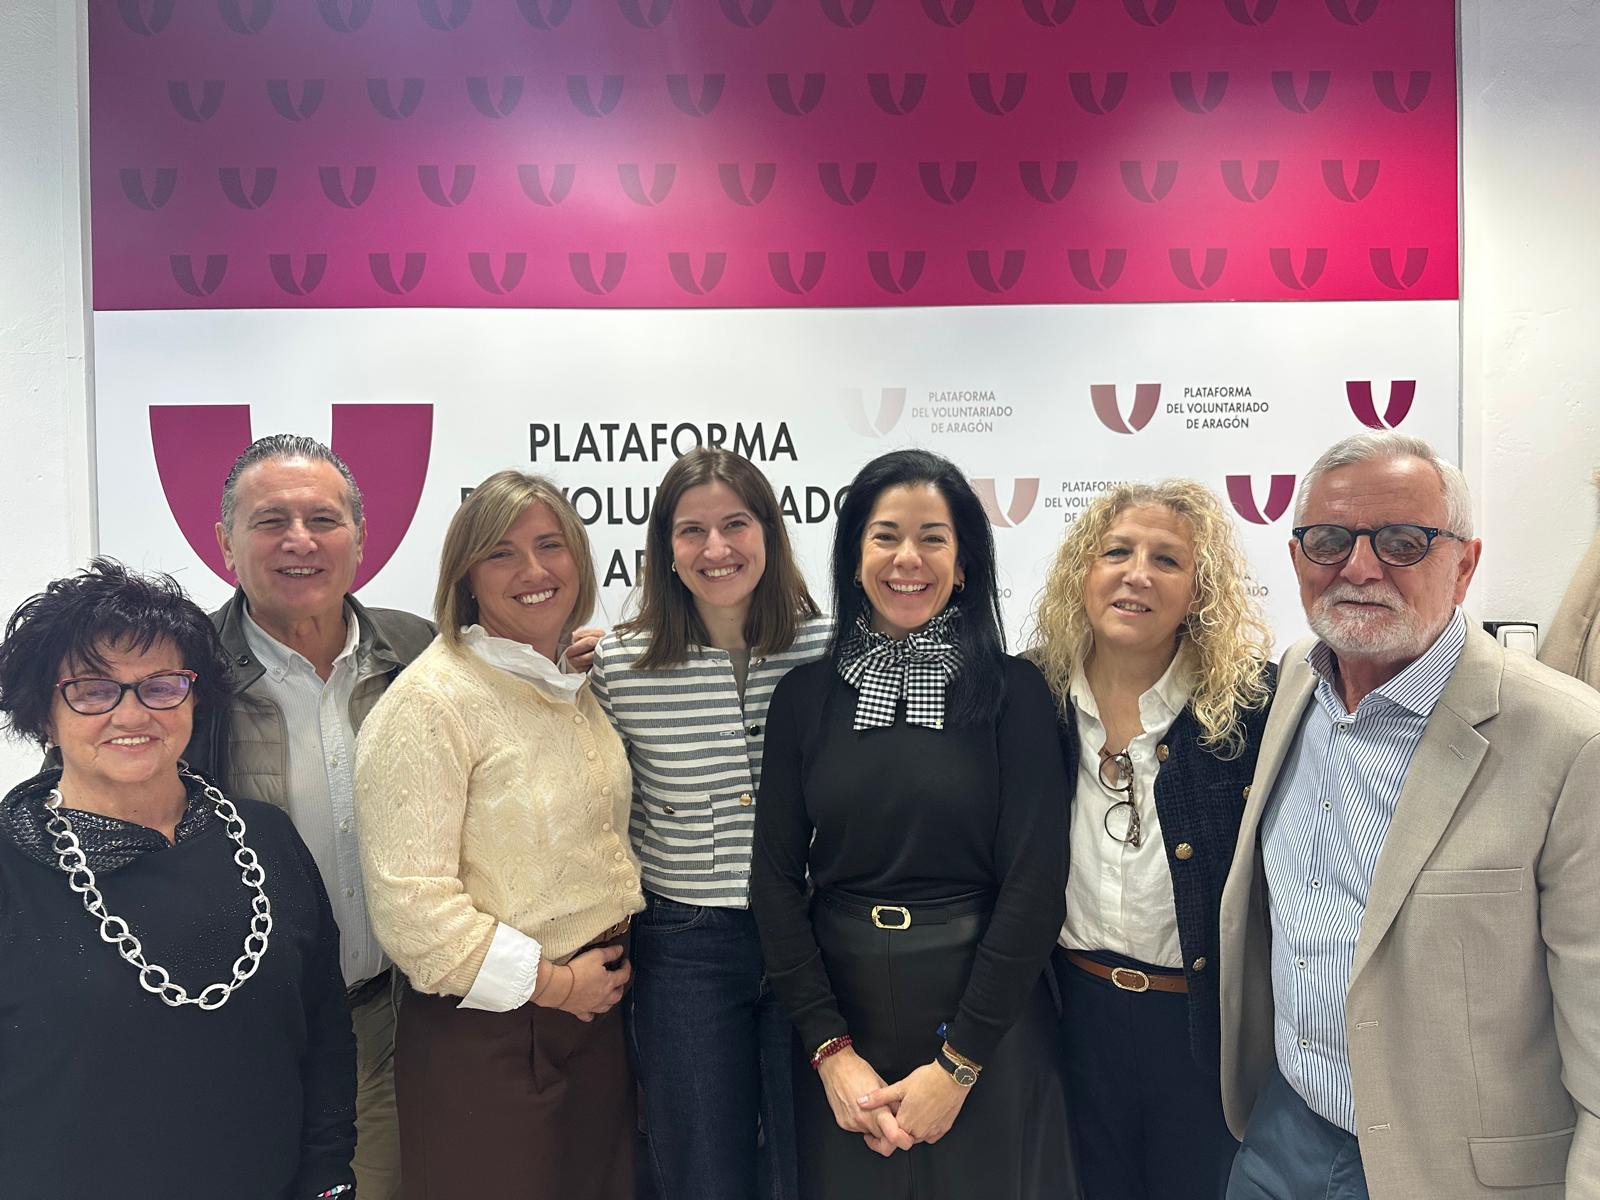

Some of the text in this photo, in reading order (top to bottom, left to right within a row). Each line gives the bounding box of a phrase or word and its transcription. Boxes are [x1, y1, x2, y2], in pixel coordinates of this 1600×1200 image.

[928, 391, 996, 402] PLATAFORMA
[1183, 386, 1252, 398] PLATAFORMA
[912, 406, 1013, 418] DEL VOLUNTARIADO
[1166, 402, 1269, 414] DEL VOLUNTARIADO
[931, 419, 993, 433] DE ARAGÓN
[1186, 415, 1249, 429] DE ARAGÓN
[529, 422, 798, 462] PLATAFORMA
[1044, 498, 1062, 508] DEL
